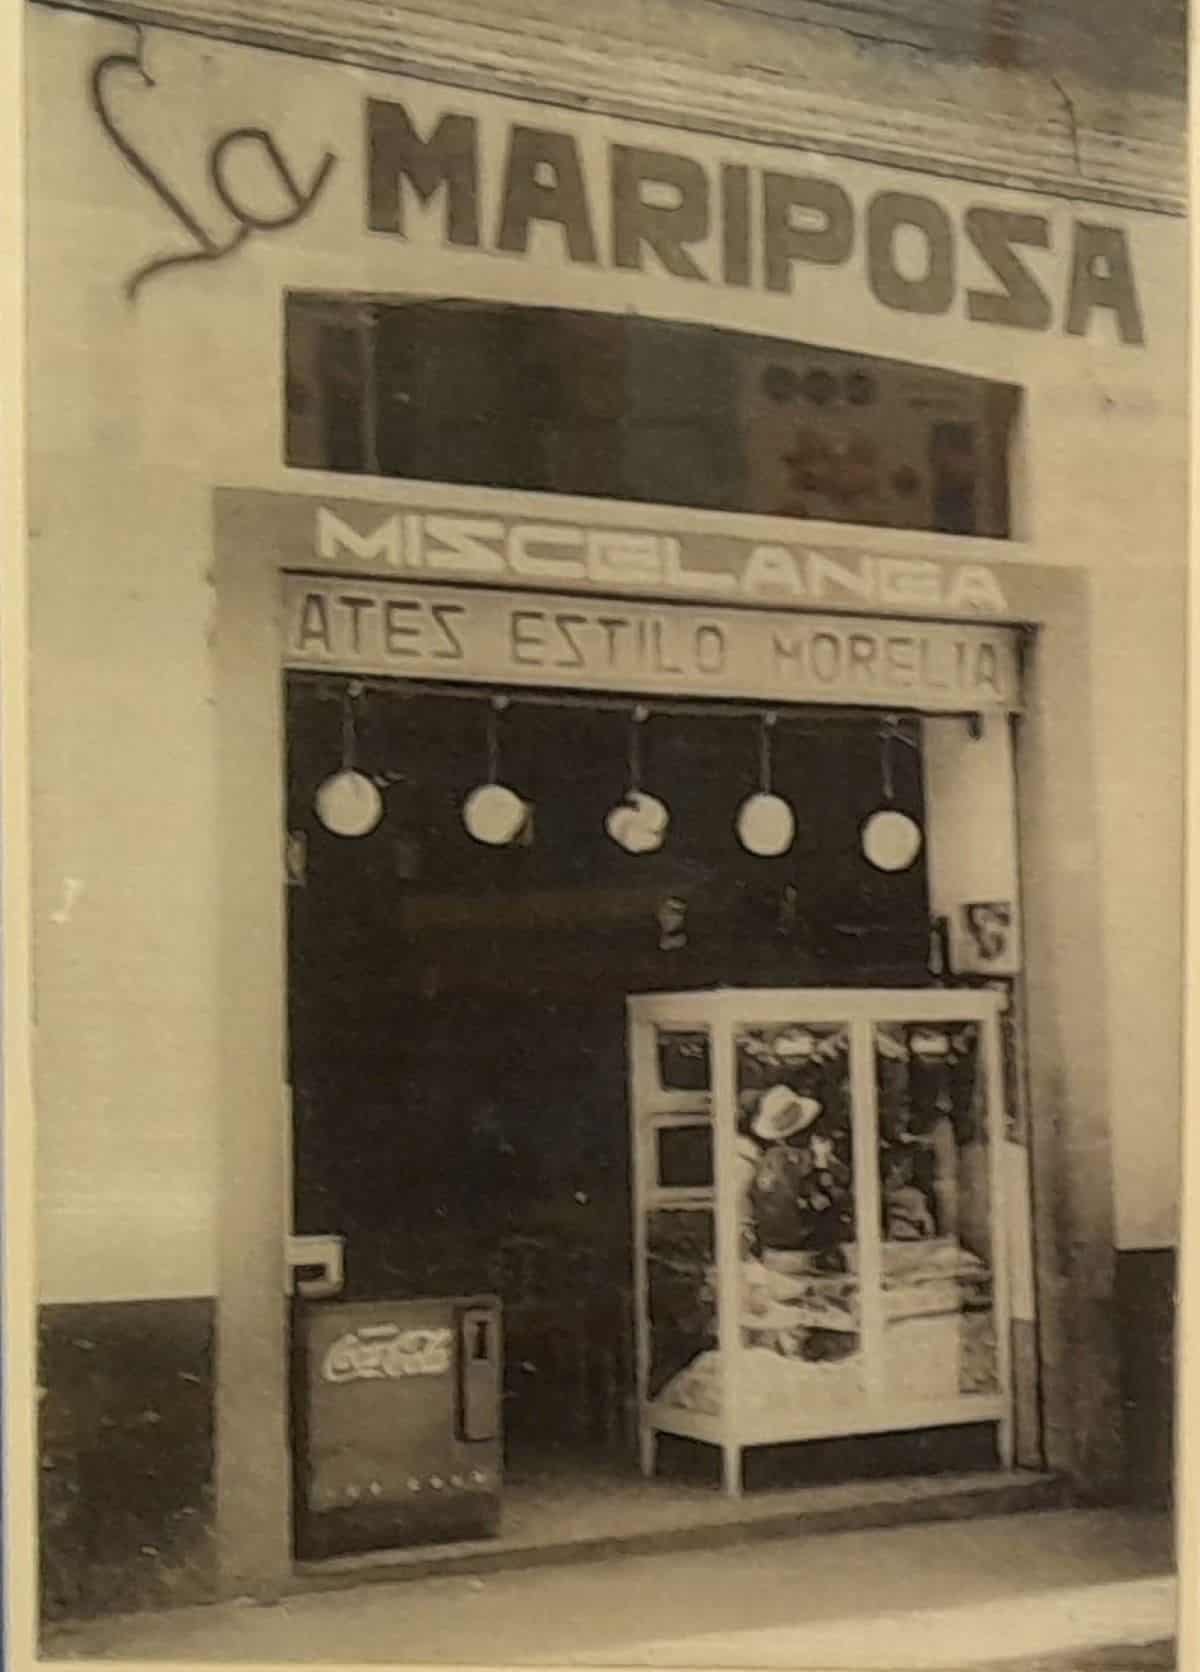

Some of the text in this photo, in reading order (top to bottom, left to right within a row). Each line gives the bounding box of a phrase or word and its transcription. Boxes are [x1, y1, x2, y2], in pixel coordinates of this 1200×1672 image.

[92, 27, 1145, 347] La MARIPOSA
[316, 507, 1007, 613] MISCELANEA
[300, 592, 1001, 695] ATES ESTILO MORELIA
